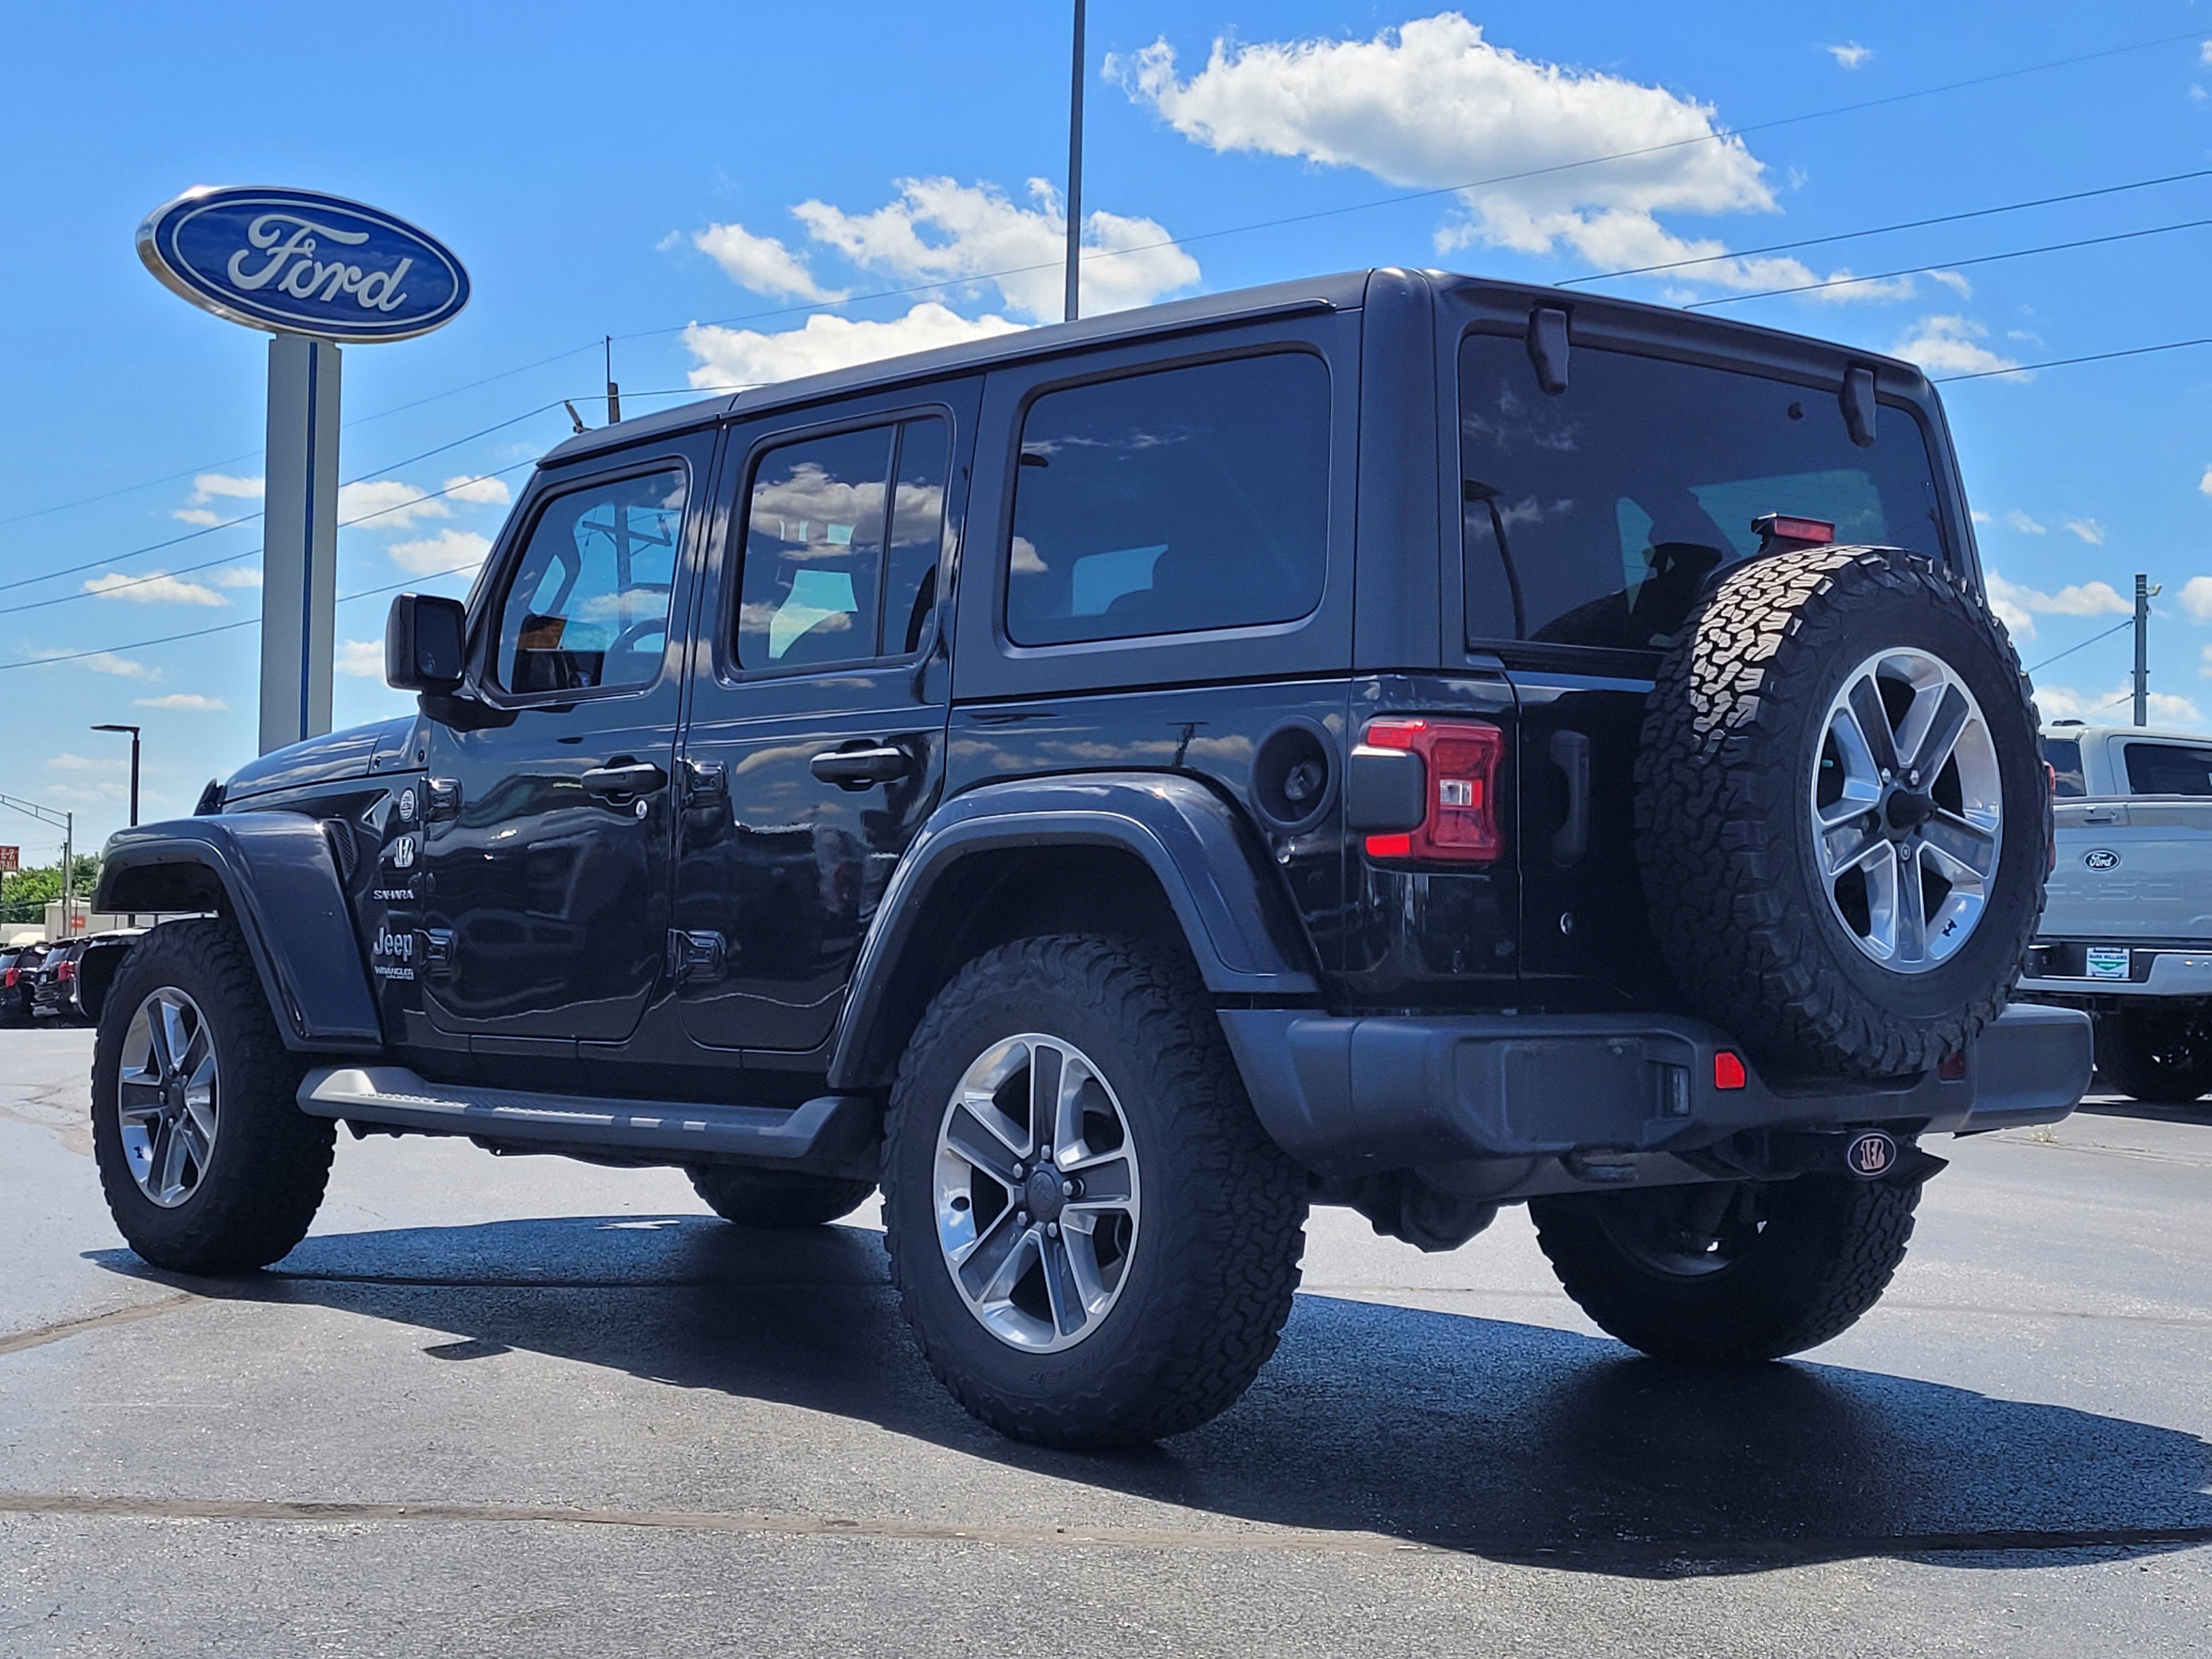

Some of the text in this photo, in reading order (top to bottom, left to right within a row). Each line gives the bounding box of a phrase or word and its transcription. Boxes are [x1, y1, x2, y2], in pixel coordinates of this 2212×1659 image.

[227, 213, 414, 312] Ford
[2089, 853, 2113, 867] Ford
[373, 889, 415, 900] SAHARA
[373, 927, 413, 962] Jeep
[374, 964, 414, 975] WRANGLER
